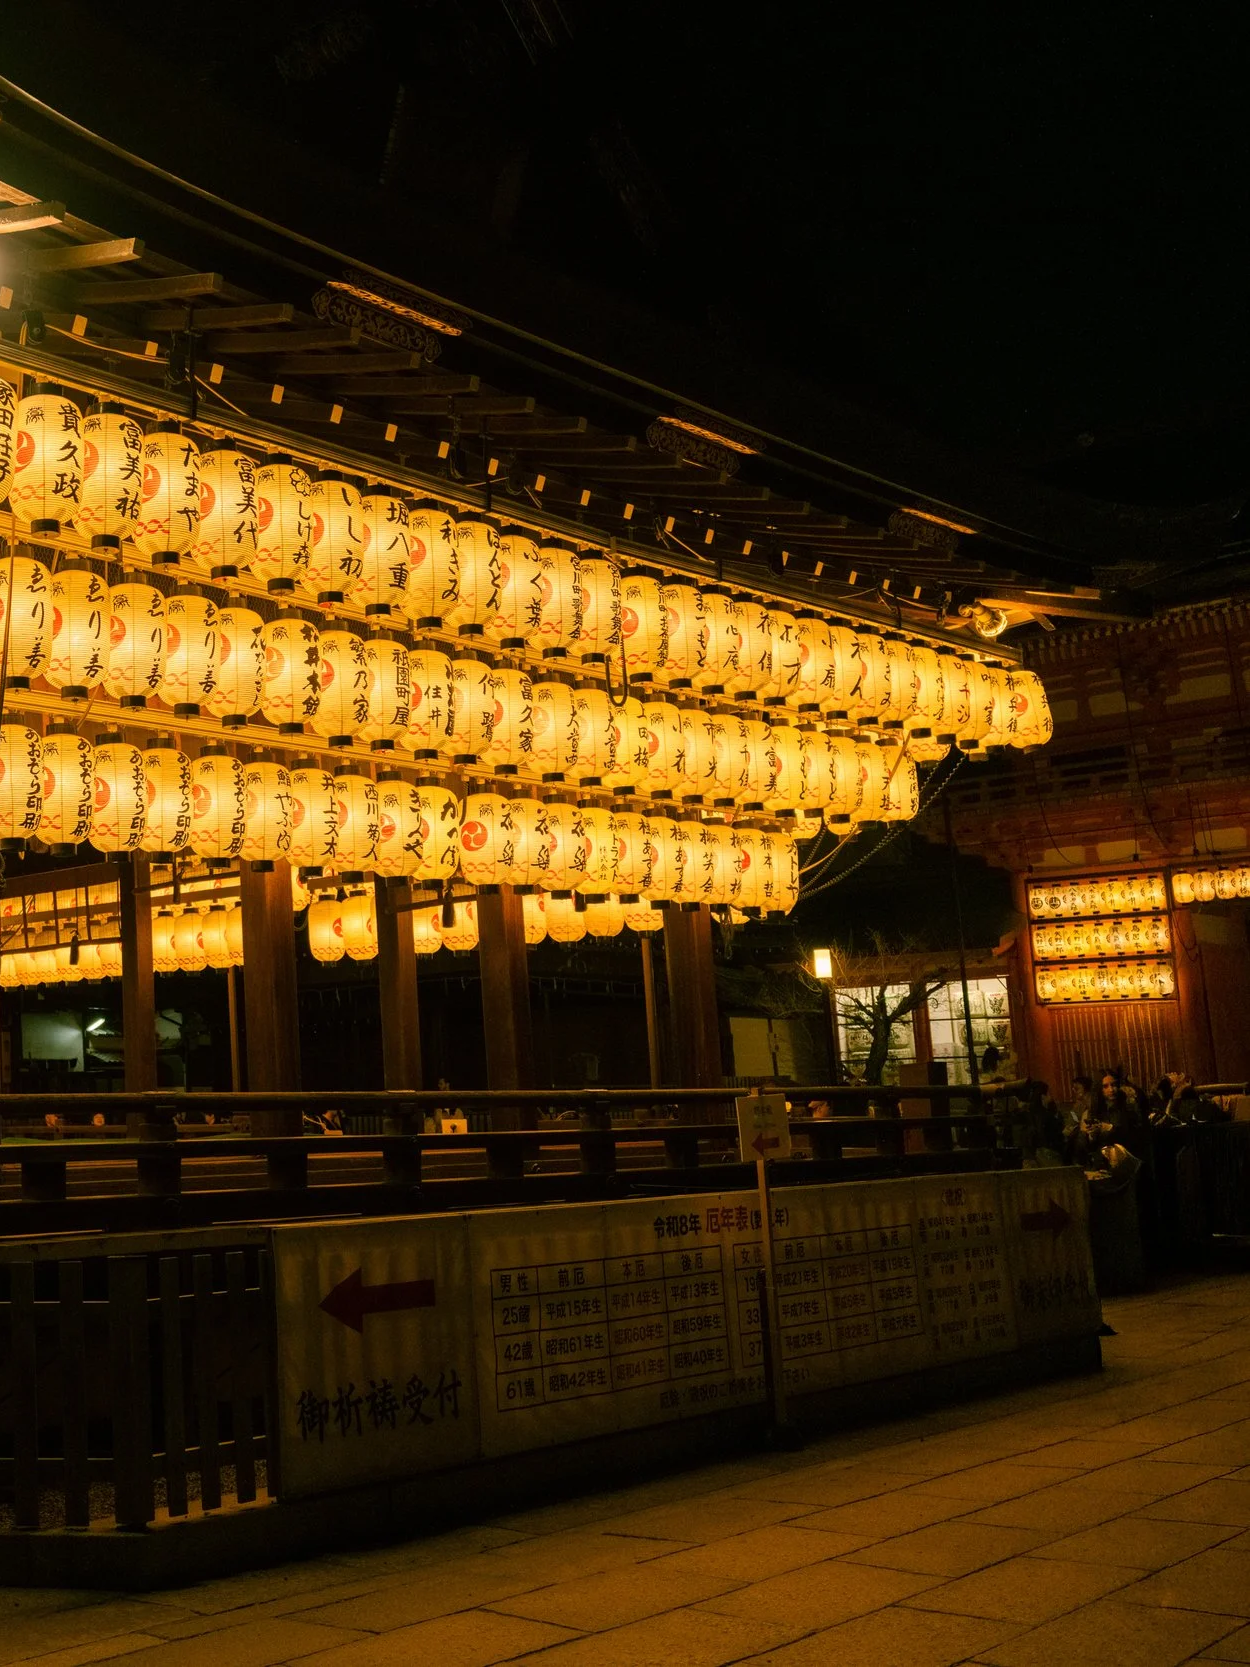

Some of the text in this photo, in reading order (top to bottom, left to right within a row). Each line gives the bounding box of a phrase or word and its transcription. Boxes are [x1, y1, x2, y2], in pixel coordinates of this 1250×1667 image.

[52, 403, 81, 504] 貴久政
[114, 420, 142, 521] 富美祐
[177, 442, 200, 533] たまや
[233, 457, 258, 551] 富美代
[25, 563, 47, 669] ゑり善
[84, 574, 105, 678] ゑり善
[146, 588, 165, 689] ゑり善
[198, 600, 219, 694] ゑり善
[320, 773, 339, 859] 井上文太
[362, 783, 381, 861] 西川菊人
[653, 1212, 702, 1240] 令和8年
[705, 1205, 749, 1234] 厄年表
[557, 1267, 585, 1287] 前厄
[622, 1260, 646, 1281] 本厄
[500, 1273, 529, 1293] 男性
[670, 1280, 719, 1302] 平成13年生
[545, 1298, 602, 1320] 平成15年生
[612, 1288, 661, 1309] 平成14年生
[502, 1304, 531, 1326] 25歳
[673, 1313, 722, 1336] 昭和59年生
[545, 1332, 604, 1355] 昭和61年生
[614, 1322, 664, 1345] 昭和60年生
[504, 1340, 533, 1362] 42歳
[549, 1368, 608, 1392] 昭和42年生
[616, 1358, 666, 1381] 昭和41年生
[506, 1377, 536, 1400] 61歳
[297, 1369, 463, 1445] 御祈祷受付
